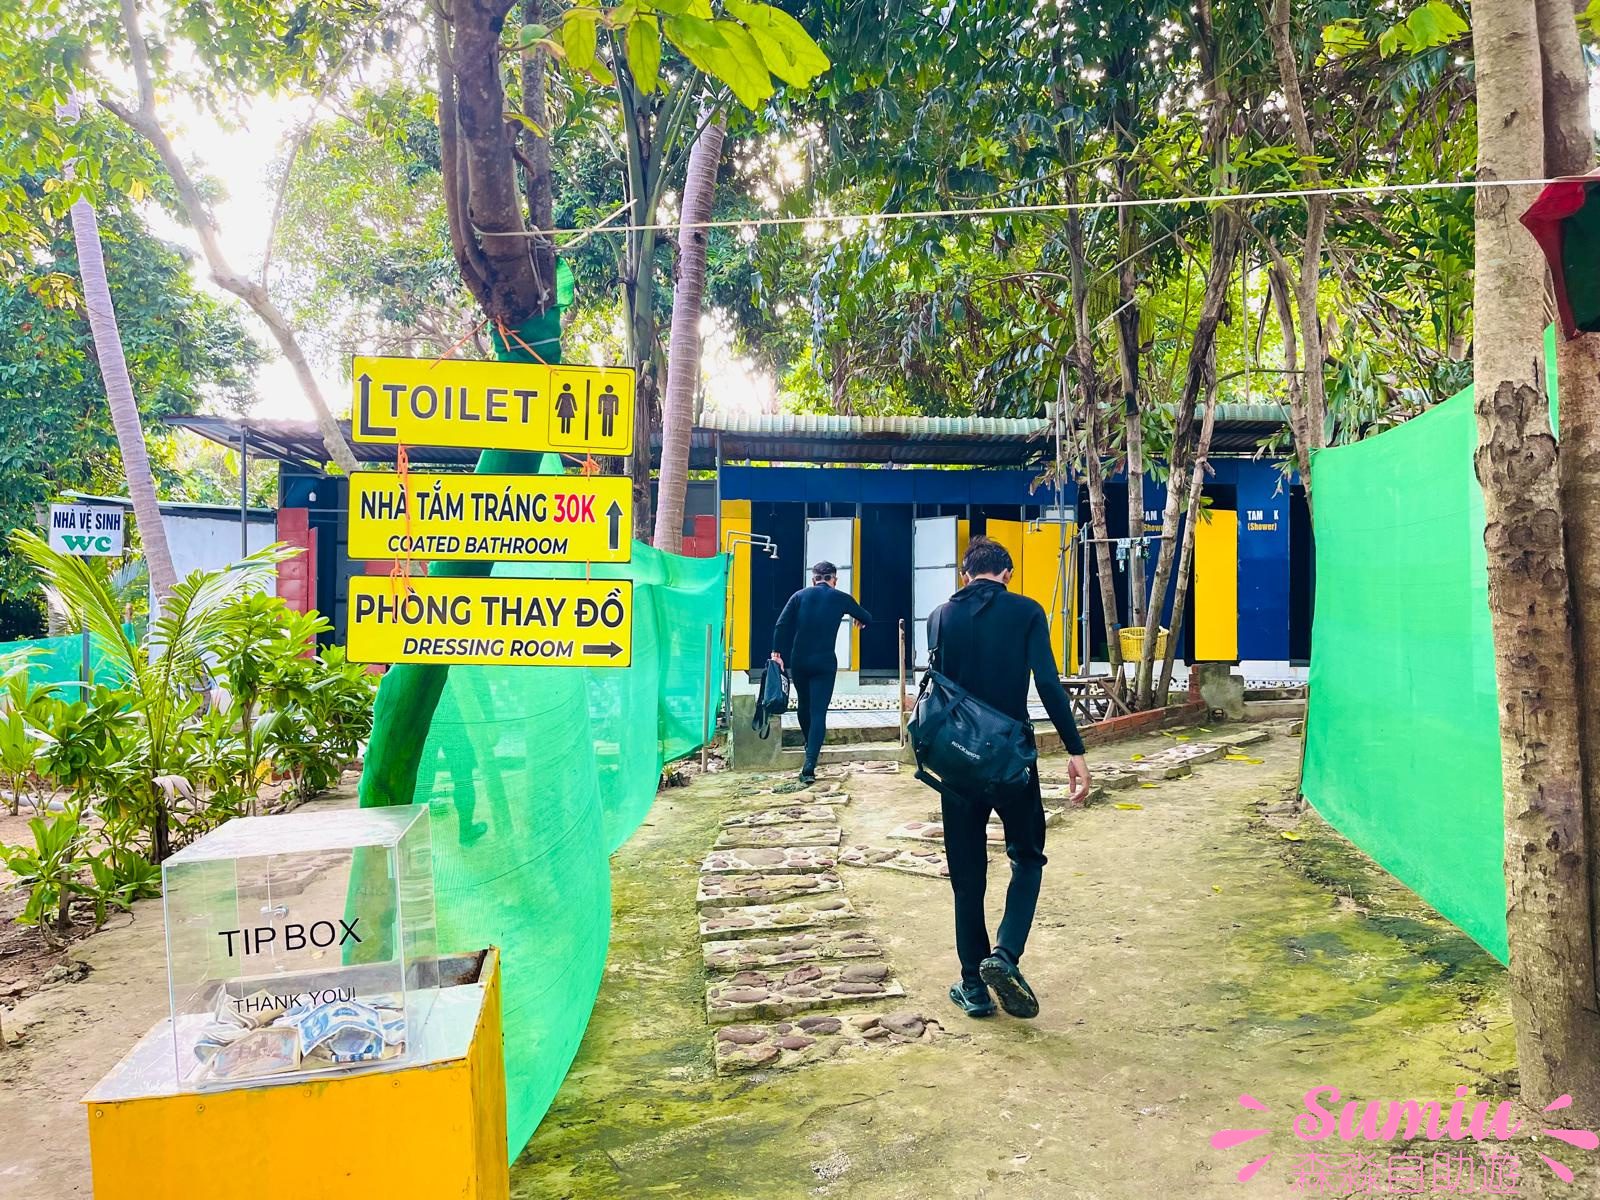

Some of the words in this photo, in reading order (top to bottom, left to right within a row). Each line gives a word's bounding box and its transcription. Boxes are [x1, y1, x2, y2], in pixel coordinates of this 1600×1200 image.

[382, 384, 538, 424] TOILET
[360, 484, 409, 521] NHÀ
[417, 480, 464, 522] TẮM
[470, 485, 547, 523] TRÁNG
[553, 494, 596, 523] 30K
[95, 513, 120, 531] SINH
[1248, 522, 1277, 531] (Shower)
[61, 535, 112, 552] WC
[388, 535, 460, 553] COATED
[465, 537, 568, 555] BATHROOM
[355, 586, 471, 626] PHÒNG
[481, 597, 567, 627] THAY
[574, 587, 624, 628] ĐỒ
[403, 637, 504, 657] DRESSING
[510, 640, 573, 658] ROOM
[218, 926, 277, 958] TIP
[285, 917, 363, 951] BOX
[233, 992, 302, 1014] THANK
[308, 987, 357, 1006] YOU!
